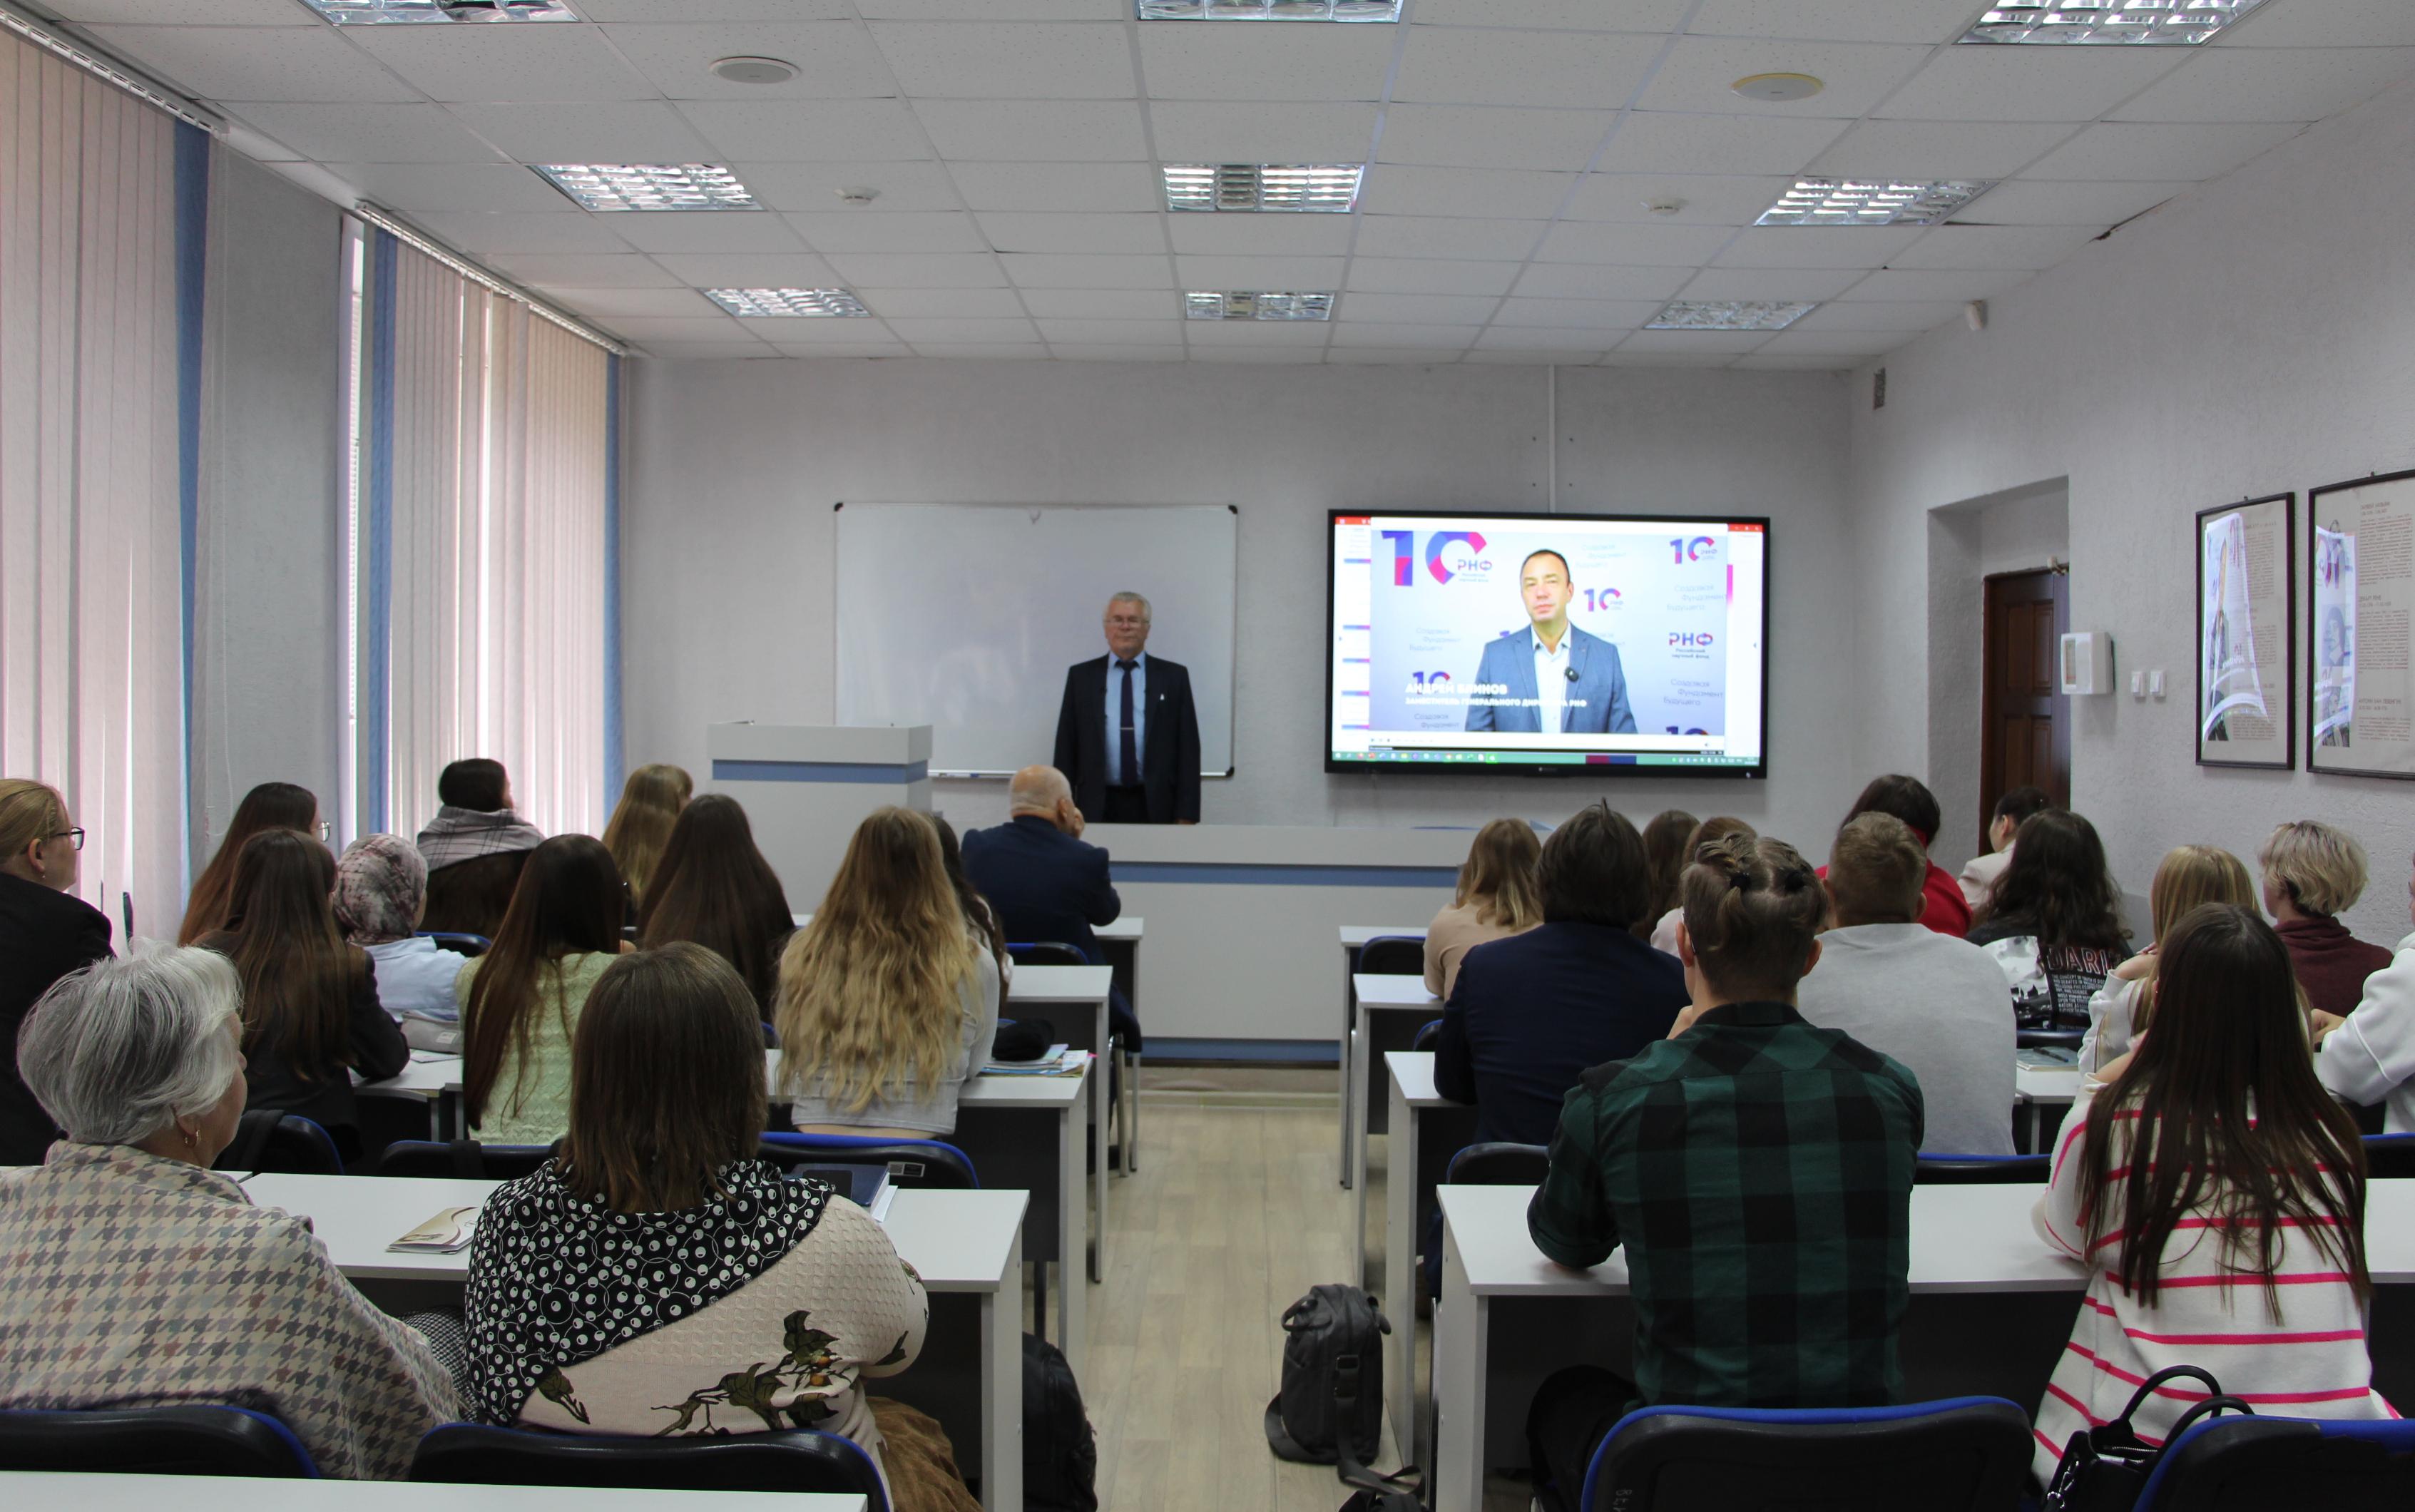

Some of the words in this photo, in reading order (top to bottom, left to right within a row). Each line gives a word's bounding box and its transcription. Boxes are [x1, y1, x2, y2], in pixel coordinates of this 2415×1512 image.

[1457, 559, 1493, 571] РНФ
[1669, 633, 1713, 645] РНФ
[1405, 683, 1455, 695] АНДРЕЙ
[1457, 684, 1508, 695] БЛИНОВ
